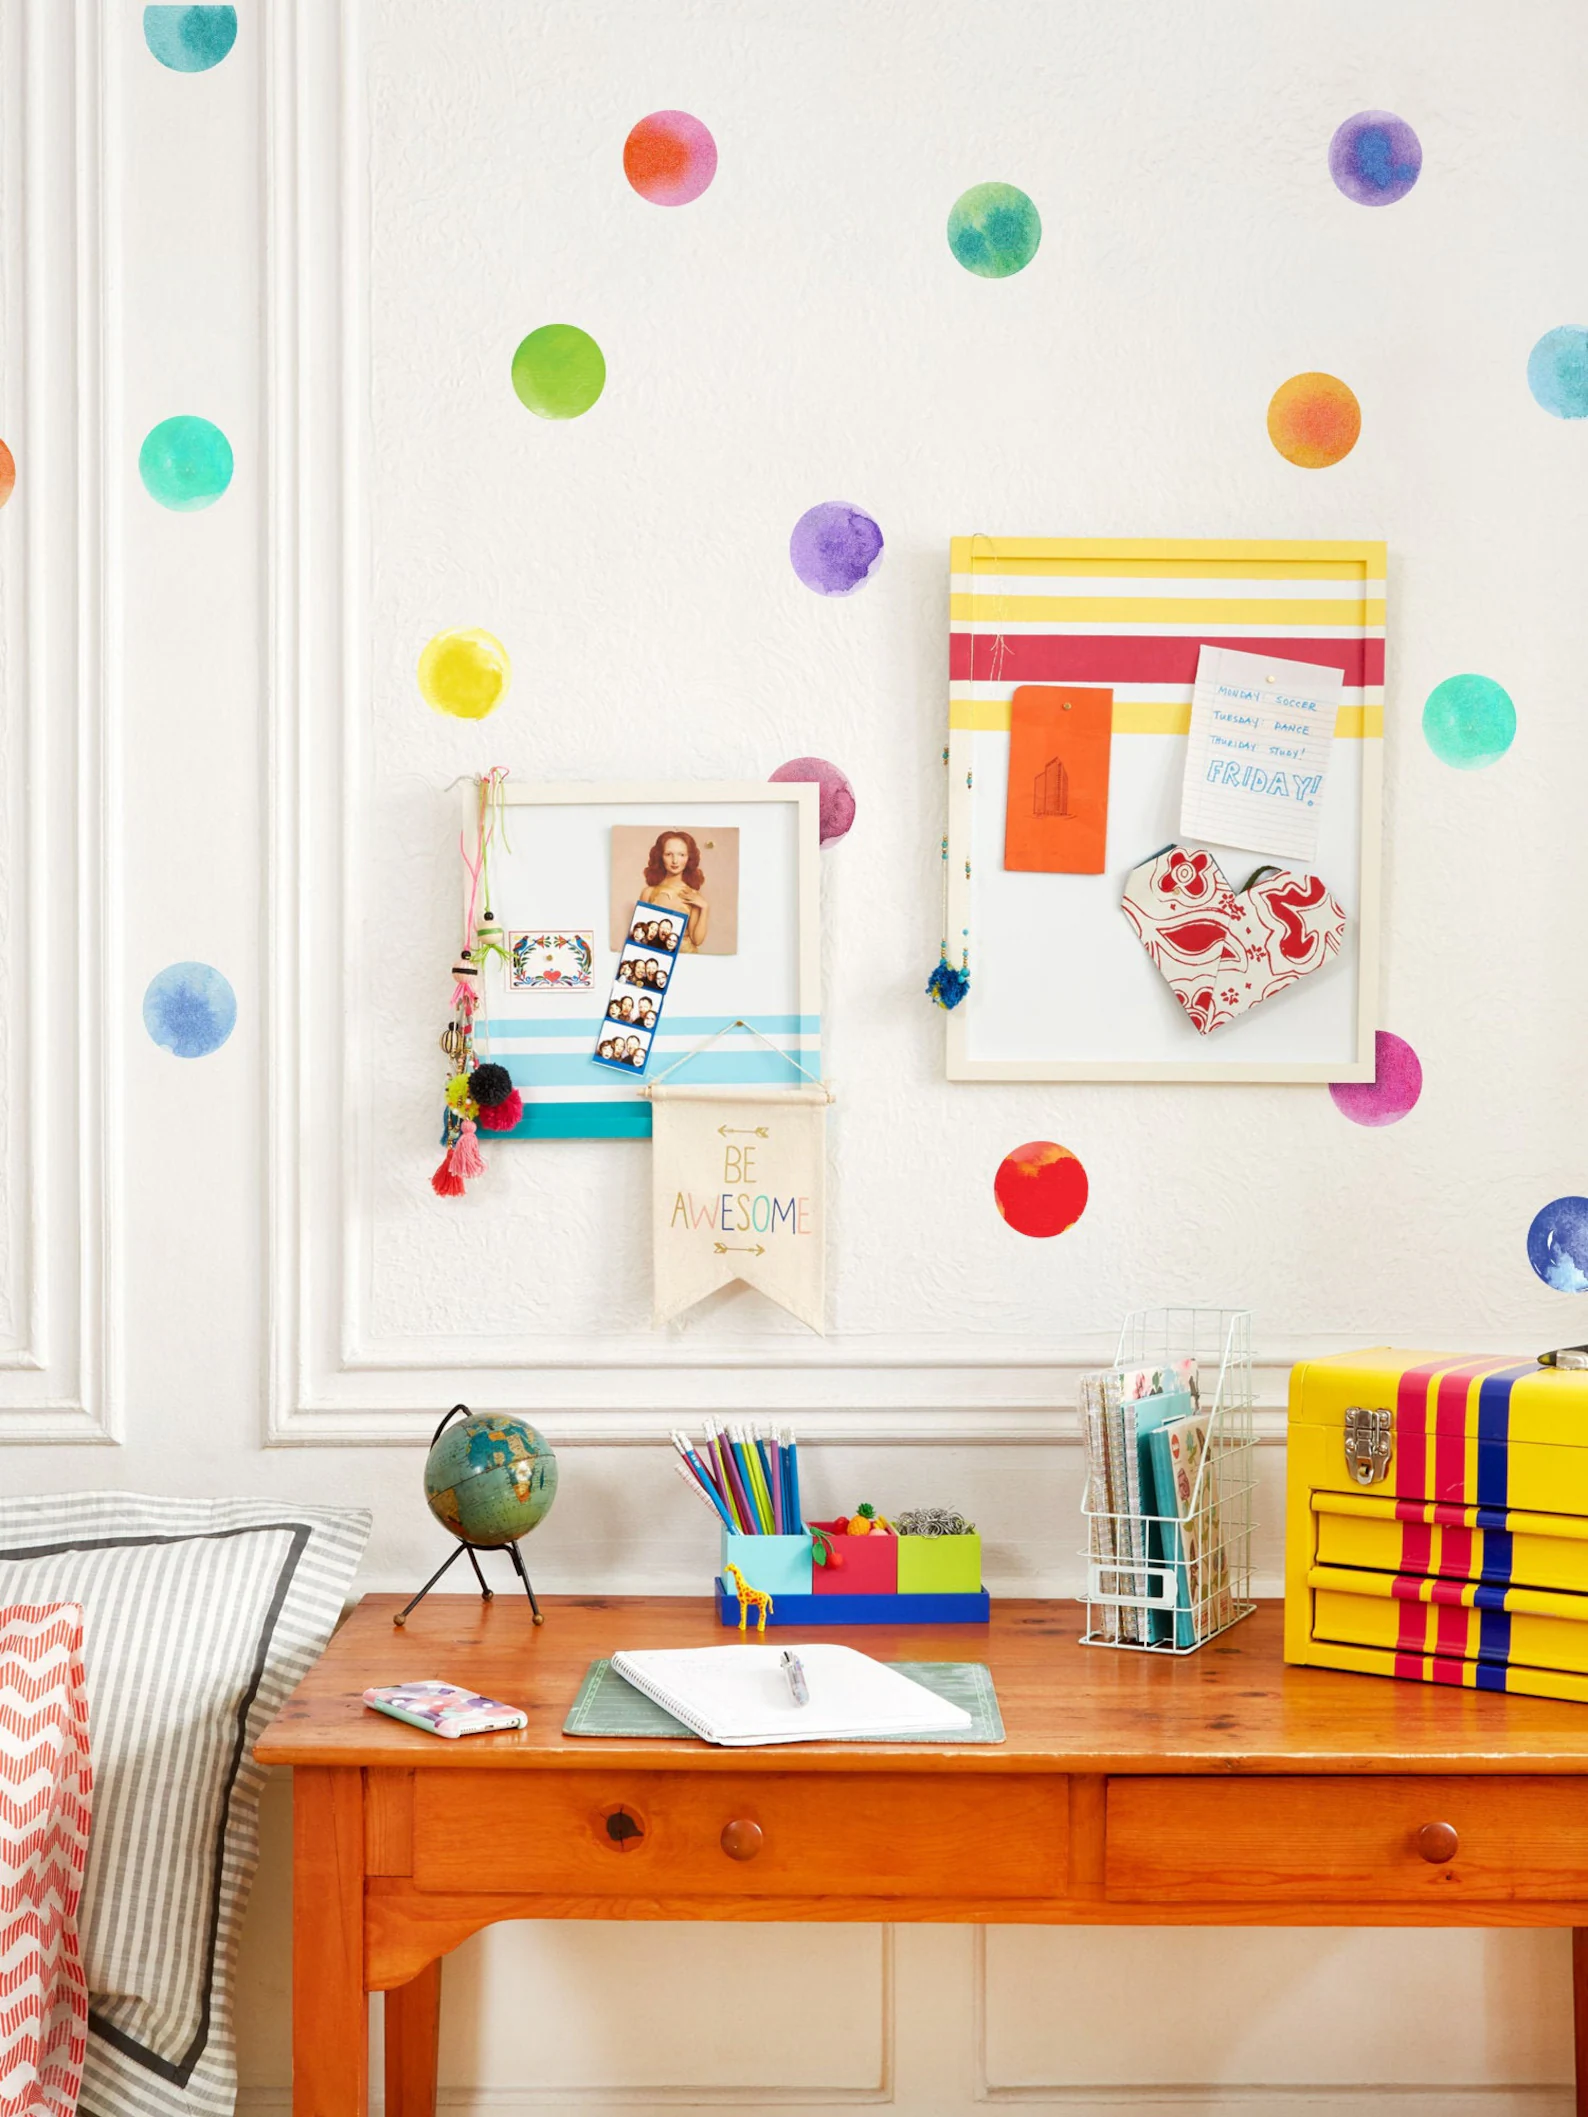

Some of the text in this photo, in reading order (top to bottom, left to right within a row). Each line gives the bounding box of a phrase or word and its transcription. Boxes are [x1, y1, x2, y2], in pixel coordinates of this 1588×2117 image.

[1275, 696, 1317, 712] SOCCER
[1274, 721, 1310, 735] DANCE
[1268, 746, 1306, 760] STUDY!
[1206, 760, 1322, 807] FRIDAY!
[724, 1145, 757, 1184] BE
[671, 1191, 812, 1235] AWESOME
